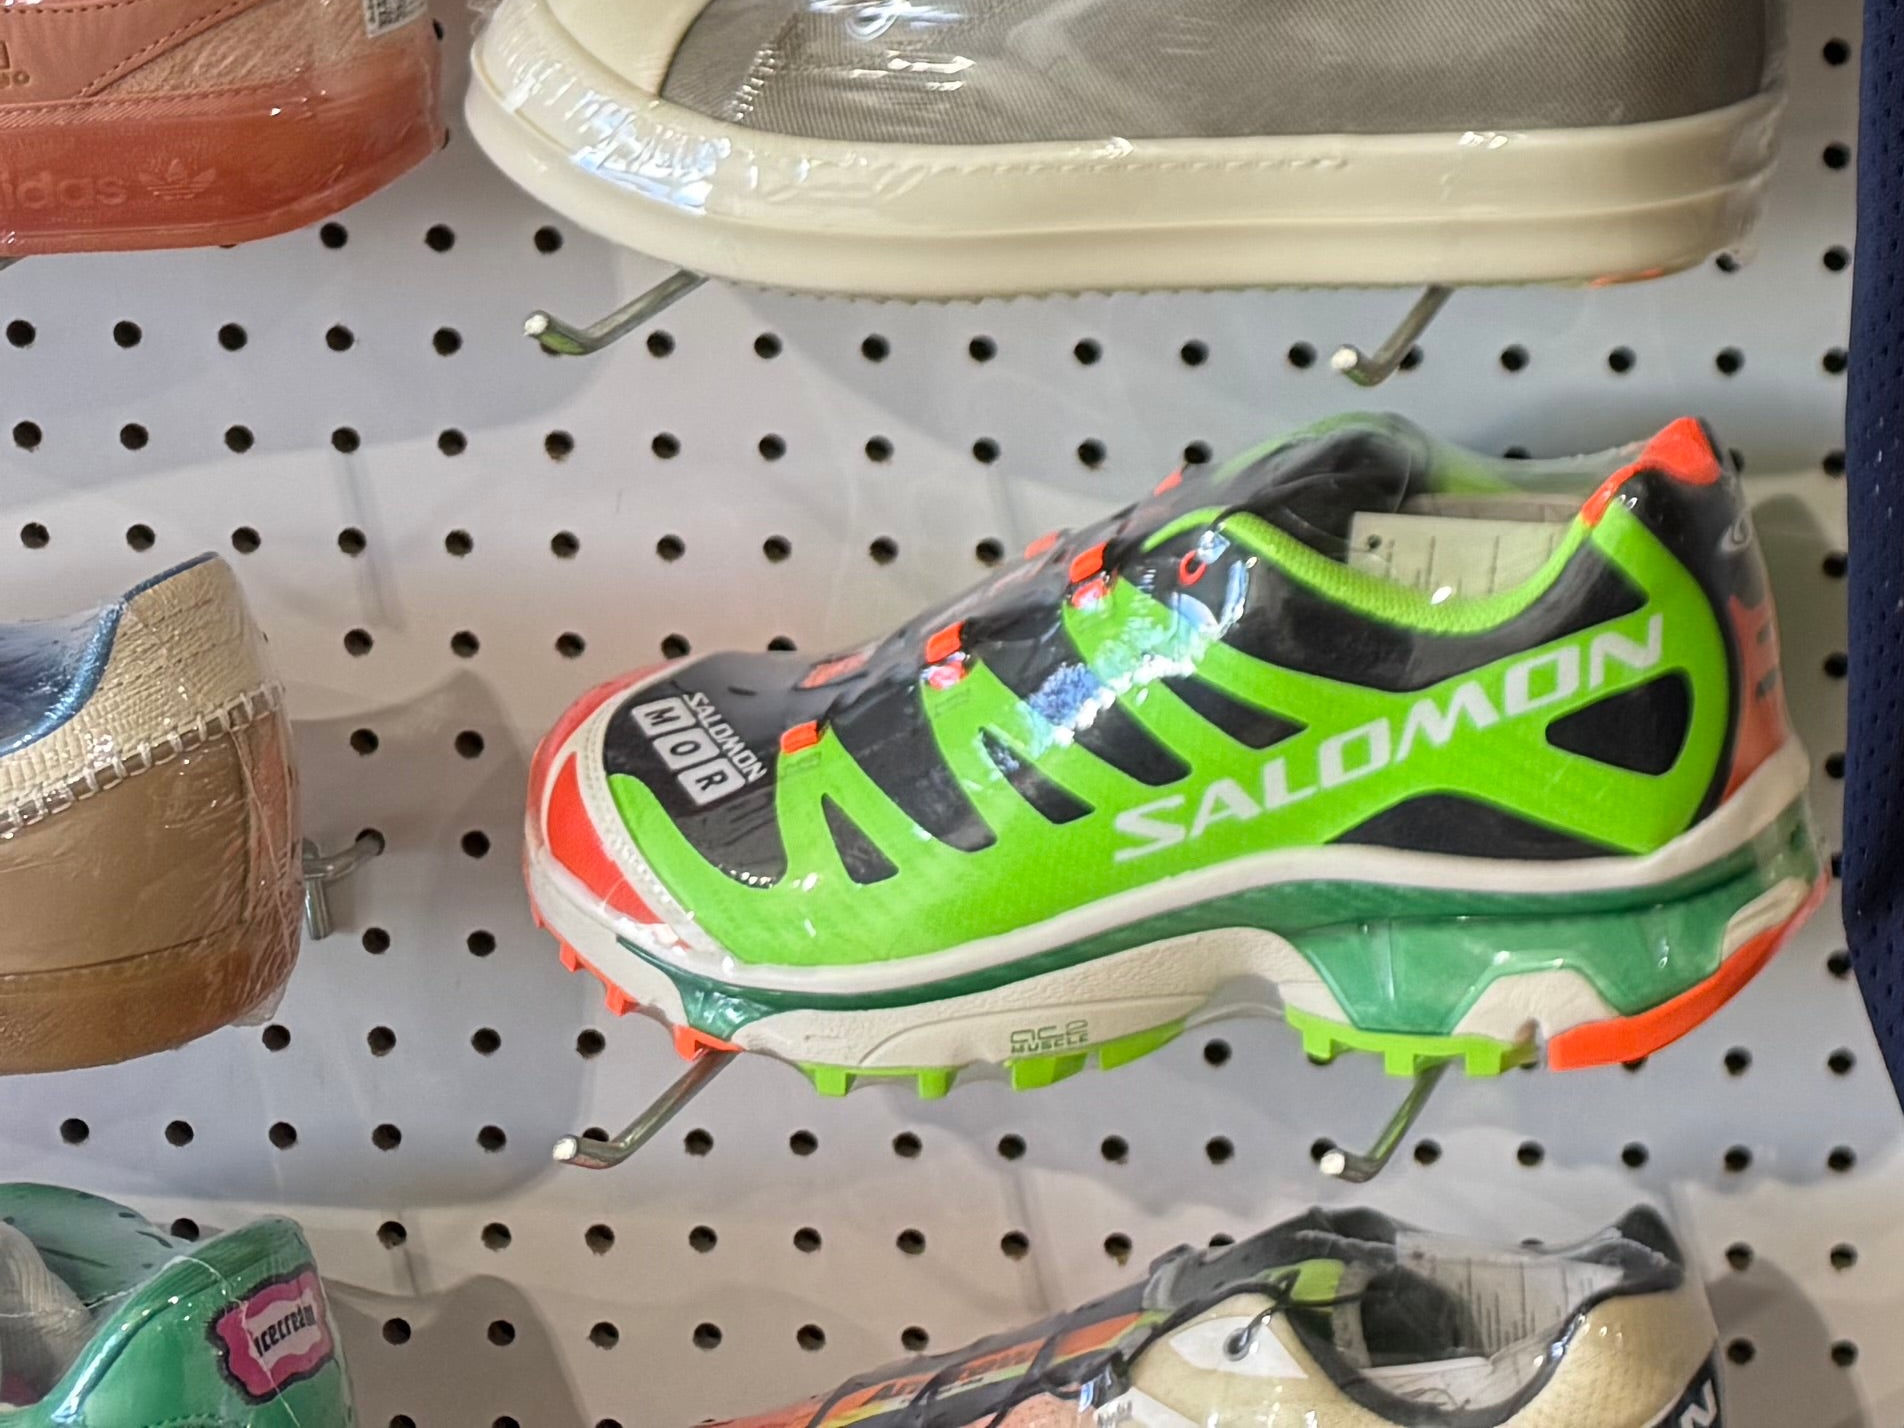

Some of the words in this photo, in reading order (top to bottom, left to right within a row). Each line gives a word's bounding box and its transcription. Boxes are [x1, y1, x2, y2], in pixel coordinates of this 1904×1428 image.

[642, 704, 731, 793] MOR
[682, 691, 768, 784] SALOMON
[1113, 612, 1664, 864] SALOMON
